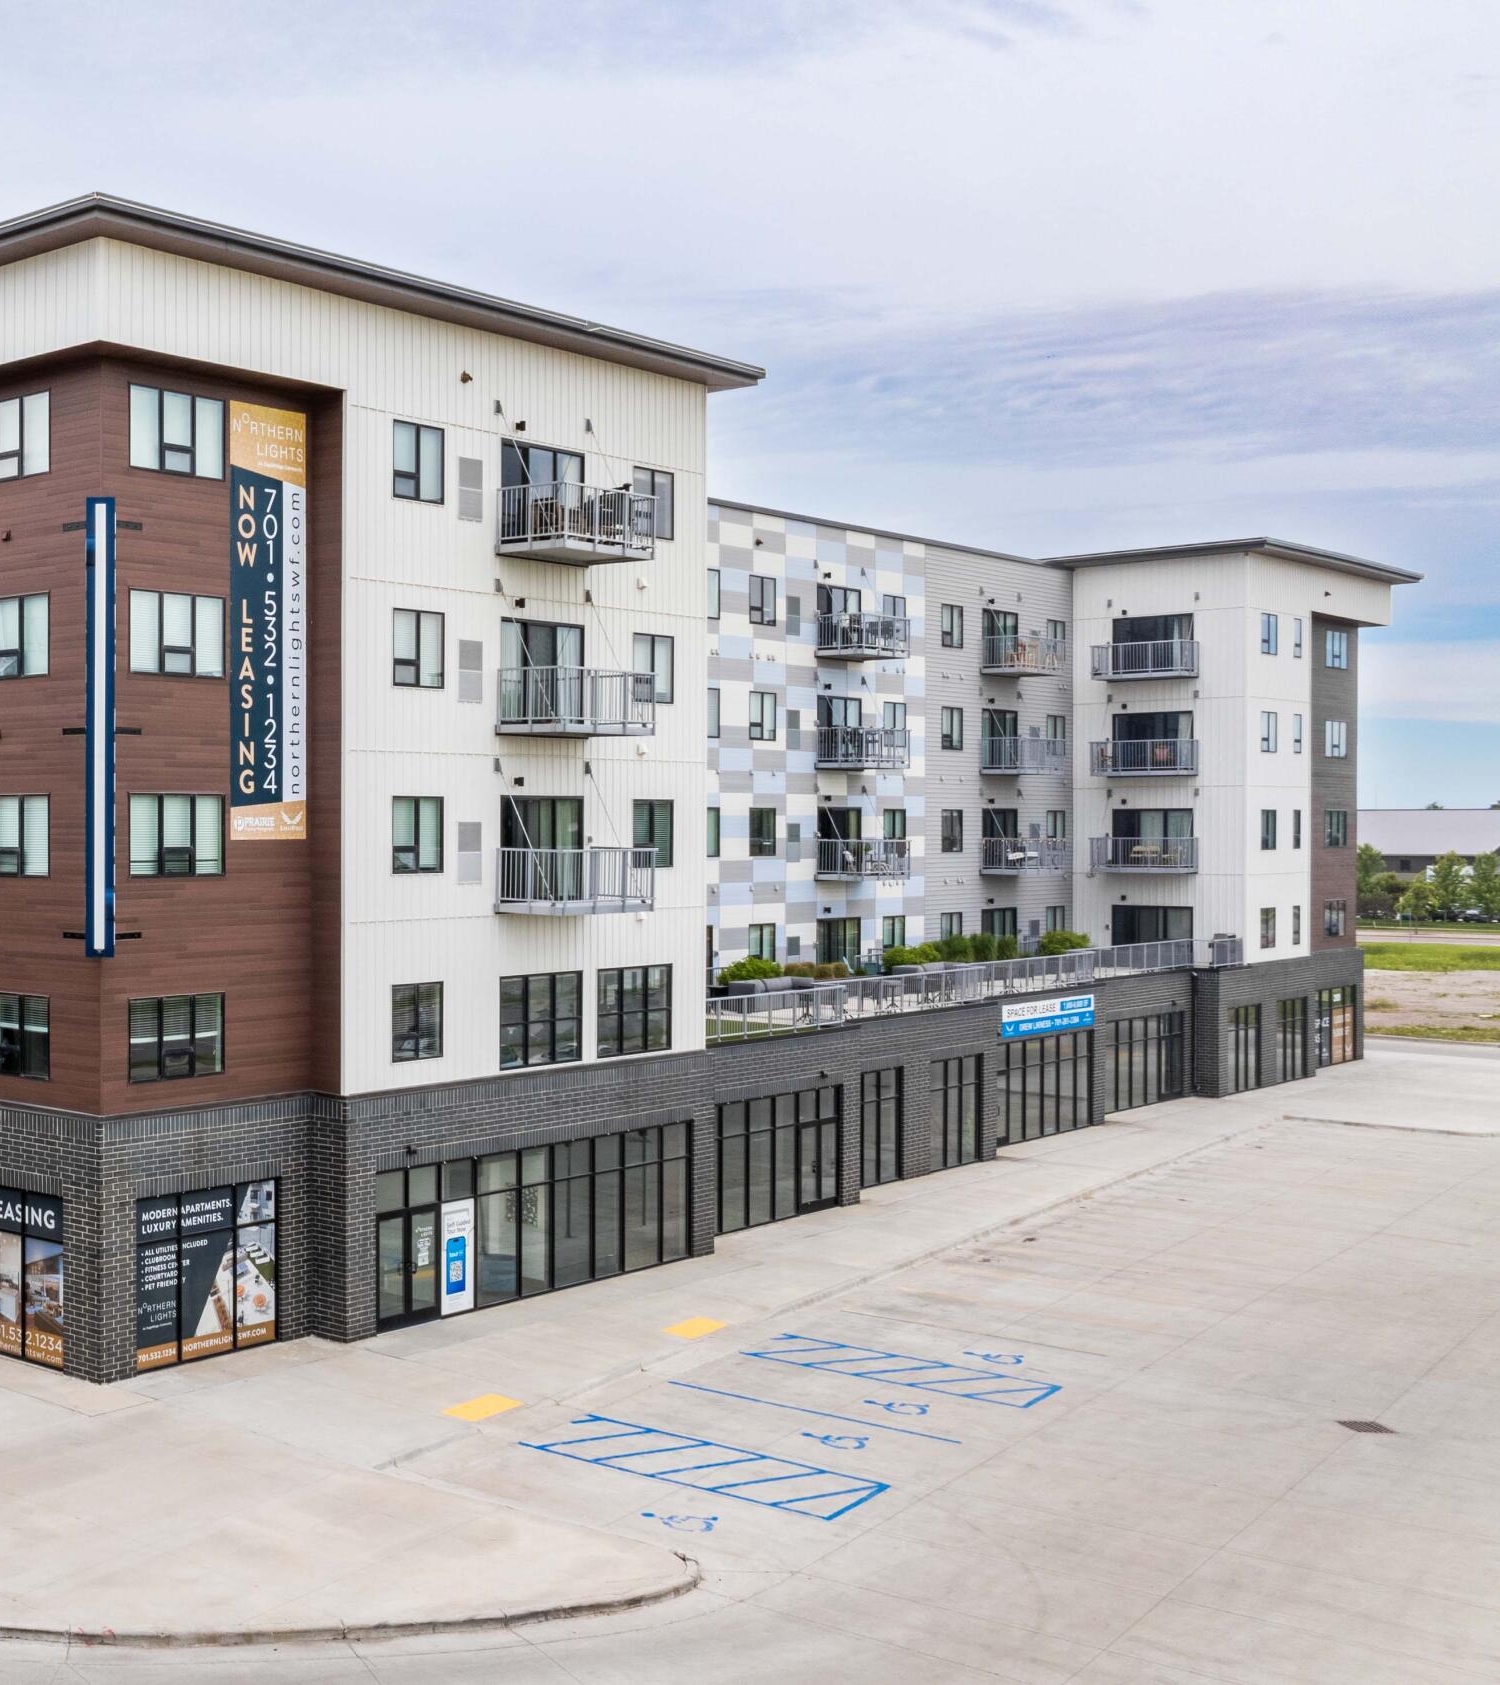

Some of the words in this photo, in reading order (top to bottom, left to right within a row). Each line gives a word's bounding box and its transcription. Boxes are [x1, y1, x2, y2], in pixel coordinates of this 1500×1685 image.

[233, 412, 303, 443] NORTHERN
[256, 441, 304, 463] LIGHTS
[236, 484, 258, 568] NOW
[289, 492, 302, 794] northernlightswf.com
[237, 598, 256, 794] LEASING
[1026, 1005, 1038, 1016] FOR
[141, 1206, 178, 1222] MODERN
[180, 1198, 233, 1215] APARTMENTS.
[141, 1219, 177, 1235] LUXURY
[180, 1212, 224, 1228] AMENITIES.
[144, 1249, 155, 1257] ALL
[182, 1239, 208, 1250] NCLUDED
[144, 1253, 177, 1265] CLUBROOM
[144, 1263, 167, 1274] FITNESS
[144, 1270, 178, 1283] COURTYARD
[144, 1283, 155, 1292] PET
[156, 1276, 186, 1289] FRIENDY
[137, 1299, 177, 1315] NORTHERN
[150, 1310, 177, 1323] LIGHTS
[138, 1347, 177, 1364] 701.532.1234
[182, 1327, 267, 1353] NORTHERNLIGHSWF.COM
